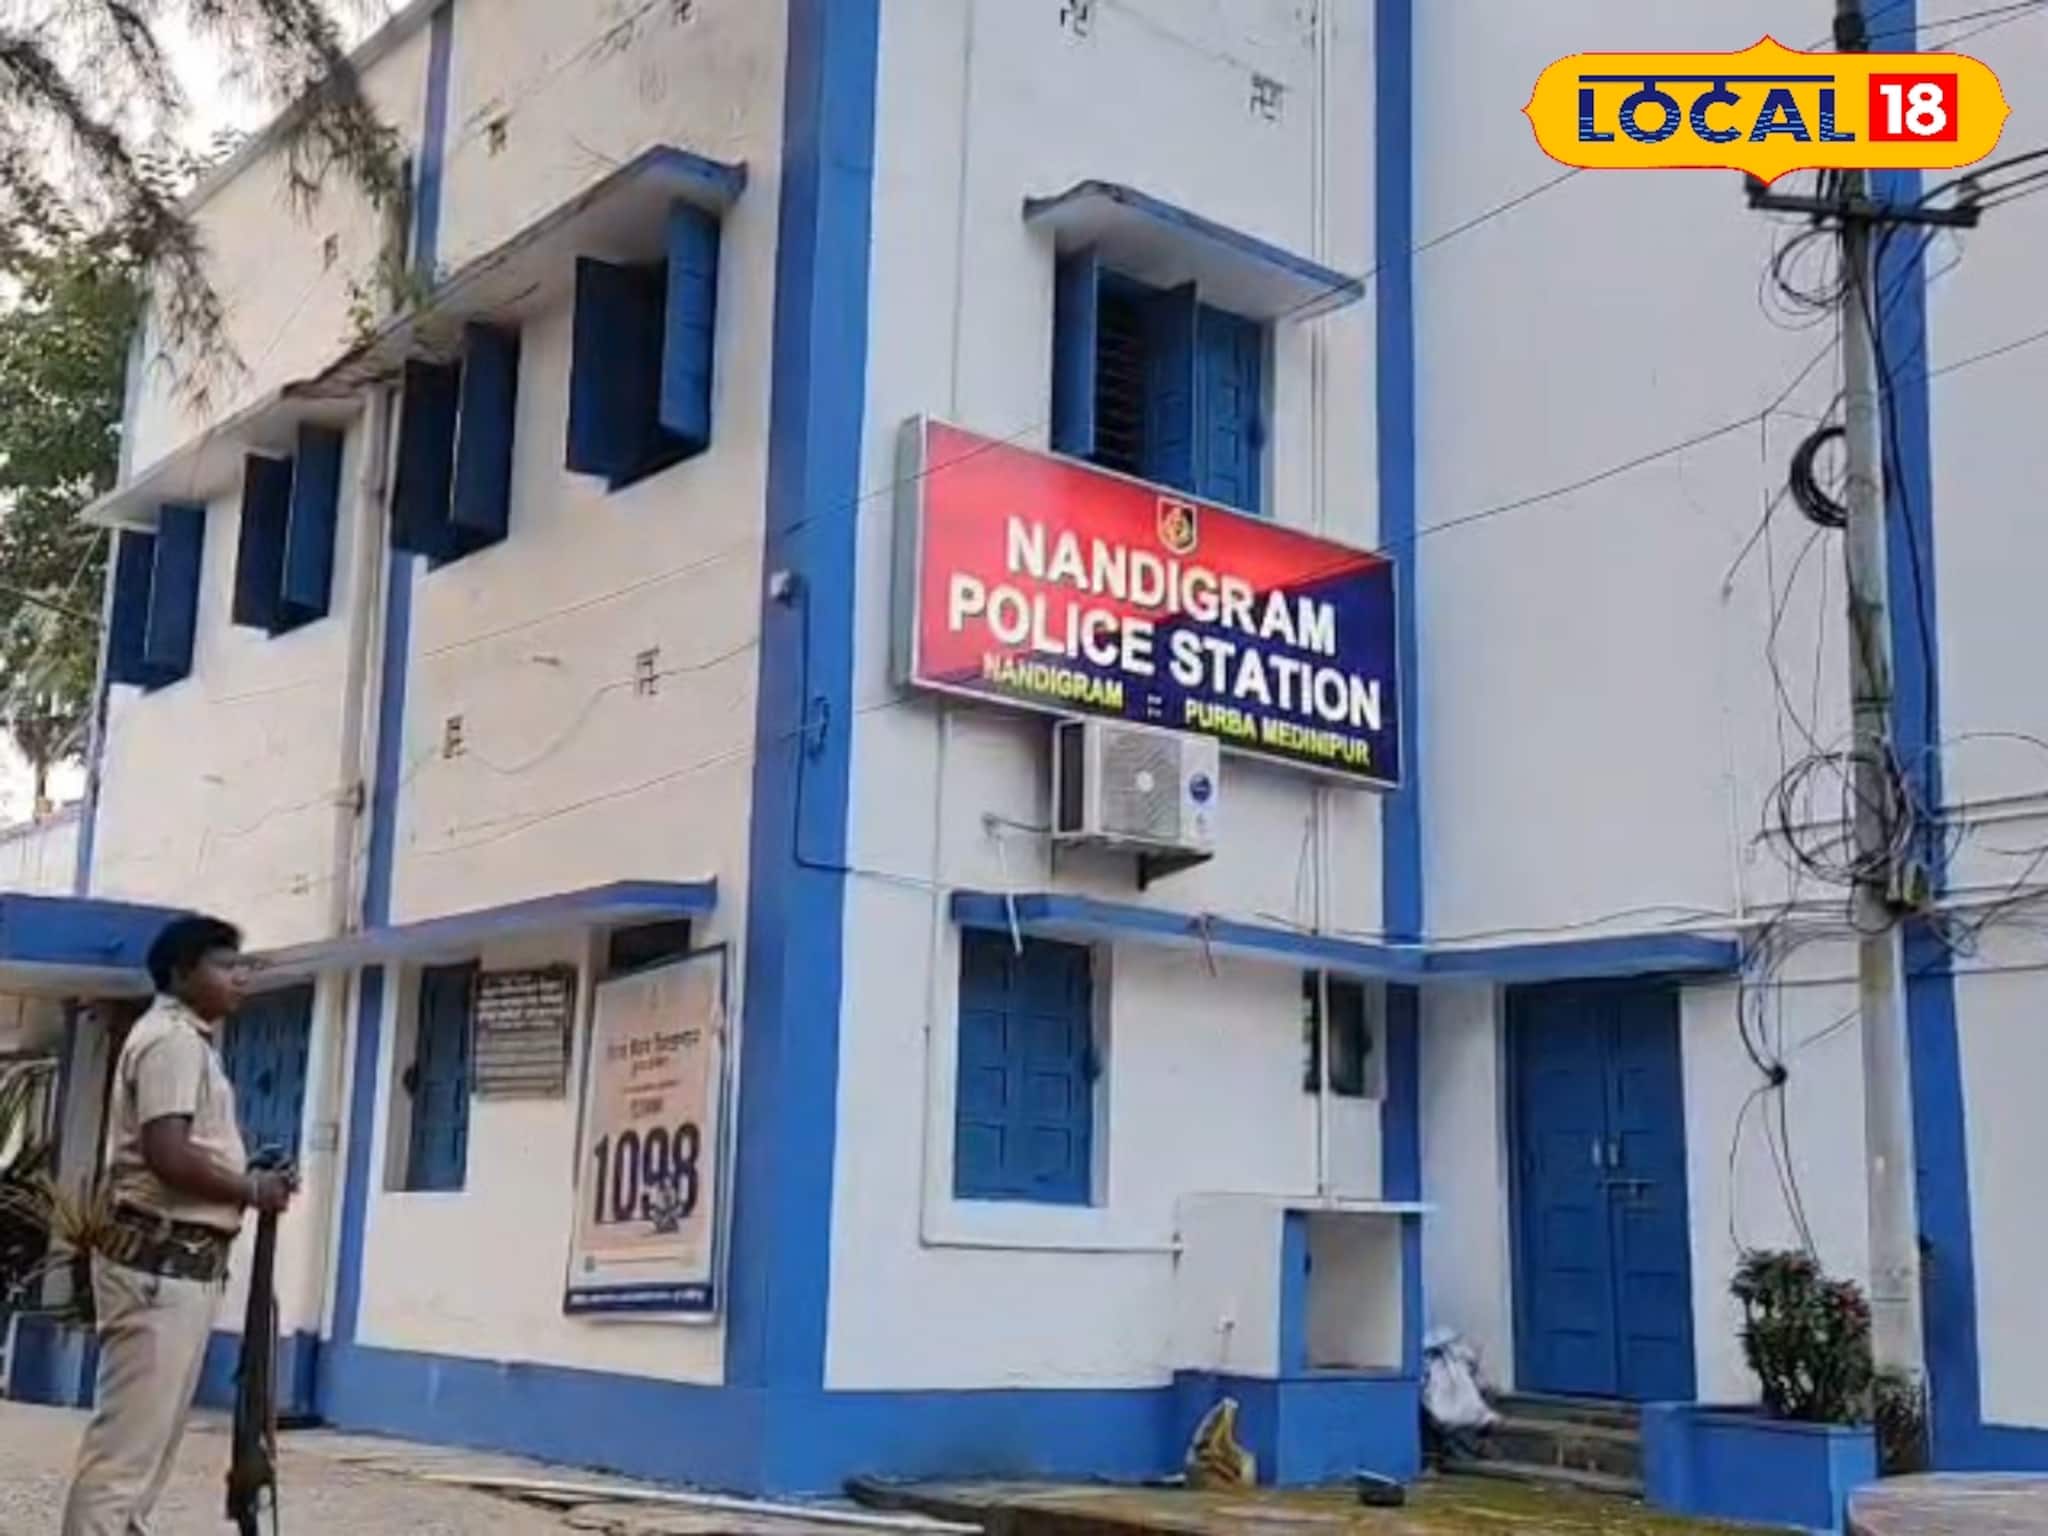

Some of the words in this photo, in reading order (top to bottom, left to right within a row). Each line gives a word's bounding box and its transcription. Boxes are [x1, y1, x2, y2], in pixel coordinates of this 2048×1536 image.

[1007, 516, 1336, 656] NANDIGRAM
[948, 573, 1155, 677] POLICE
[1169, 629, 1383, 731] STATION
[983, 653, 1125, 711] NANDIGRAM
[1184, 698, 1258, 743] PURBA
[1260, 718, 1372, 766] MEDINIPUR
[594, 1122, 700, 1226] 1098
